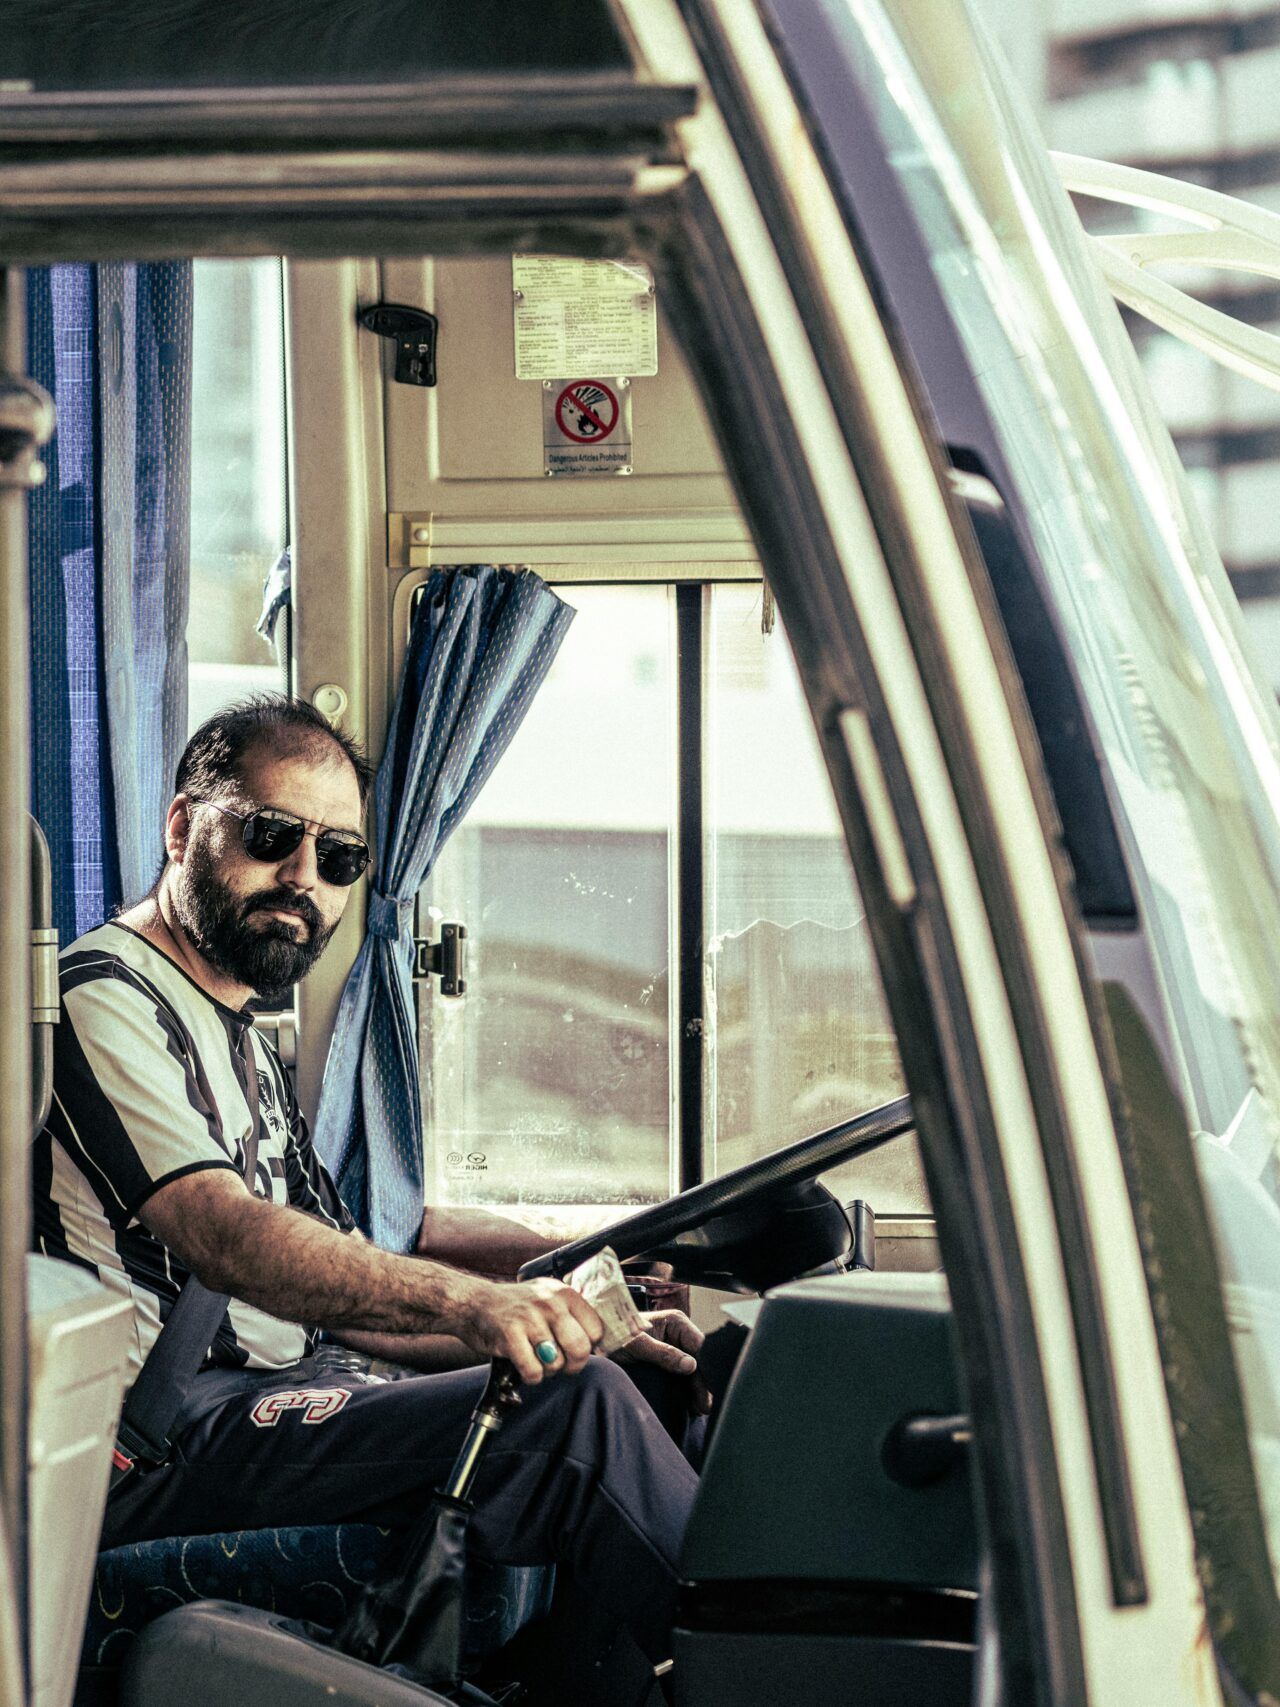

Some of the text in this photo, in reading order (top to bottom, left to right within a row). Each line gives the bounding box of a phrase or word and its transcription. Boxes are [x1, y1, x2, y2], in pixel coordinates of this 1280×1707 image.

[549, 453, 627, 464] Dangerous Articles Prohibited
[250, 1388, 353, 1428] 3
